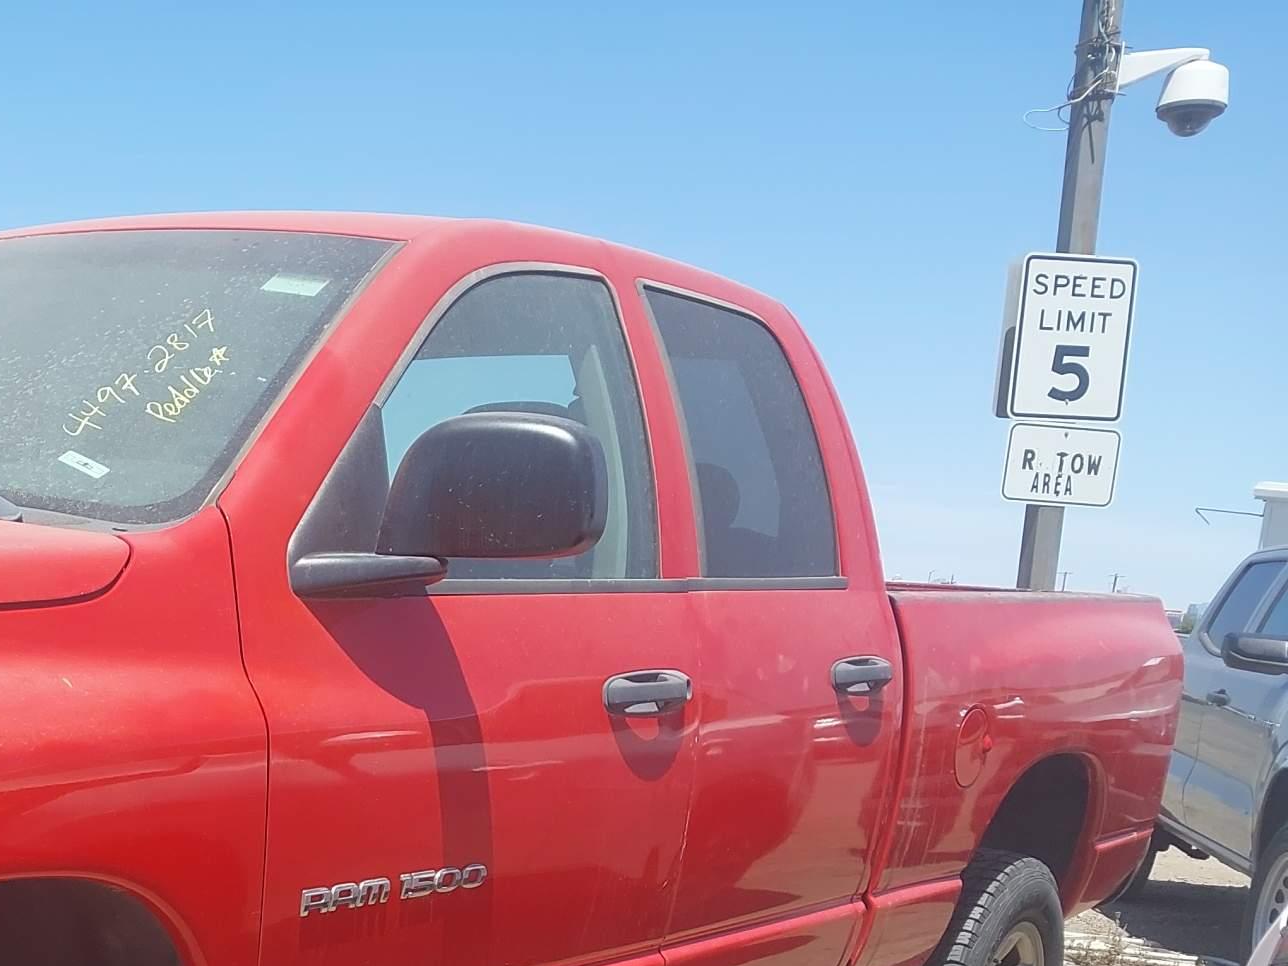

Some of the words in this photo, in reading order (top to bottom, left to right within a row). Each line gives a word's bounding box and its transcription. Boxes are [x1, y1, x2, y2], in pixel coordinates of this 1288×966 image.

[1032, 273, 1126, 300] SPEED
[1039, 309, 1113, 334] LIMIT
[62, 372, 140, 436] 4497
[147, 309, 215, 372] 2817
[1047, 344, 1091, 403] 5
[1056, 451, 1103, 476] TOW
[1030, 471, 1073, 496] AREA
[299, 877, 391, 918] RAM
[399, 863, 488, 900] 1500
